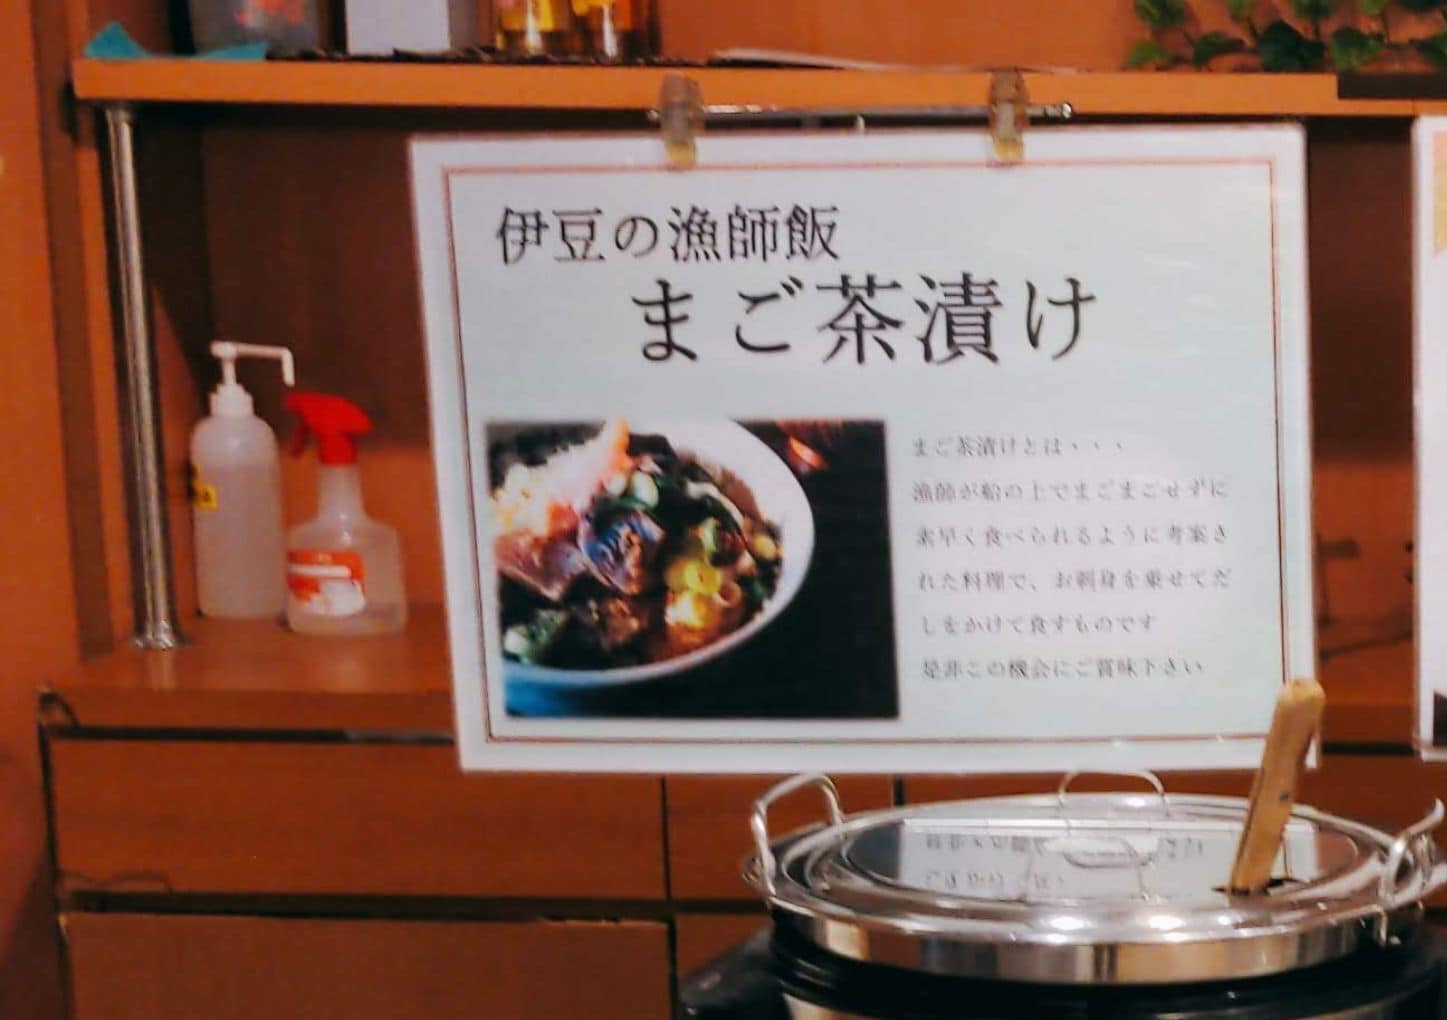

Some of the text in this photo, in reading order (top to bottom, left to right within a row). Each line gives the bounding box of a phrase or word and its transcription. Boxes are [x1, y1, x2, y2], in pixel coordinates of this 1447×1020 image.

[496, 203, 840, 264] 伊豆の漁師飯
[630, 270, 1097, 366] まご茶漬け
